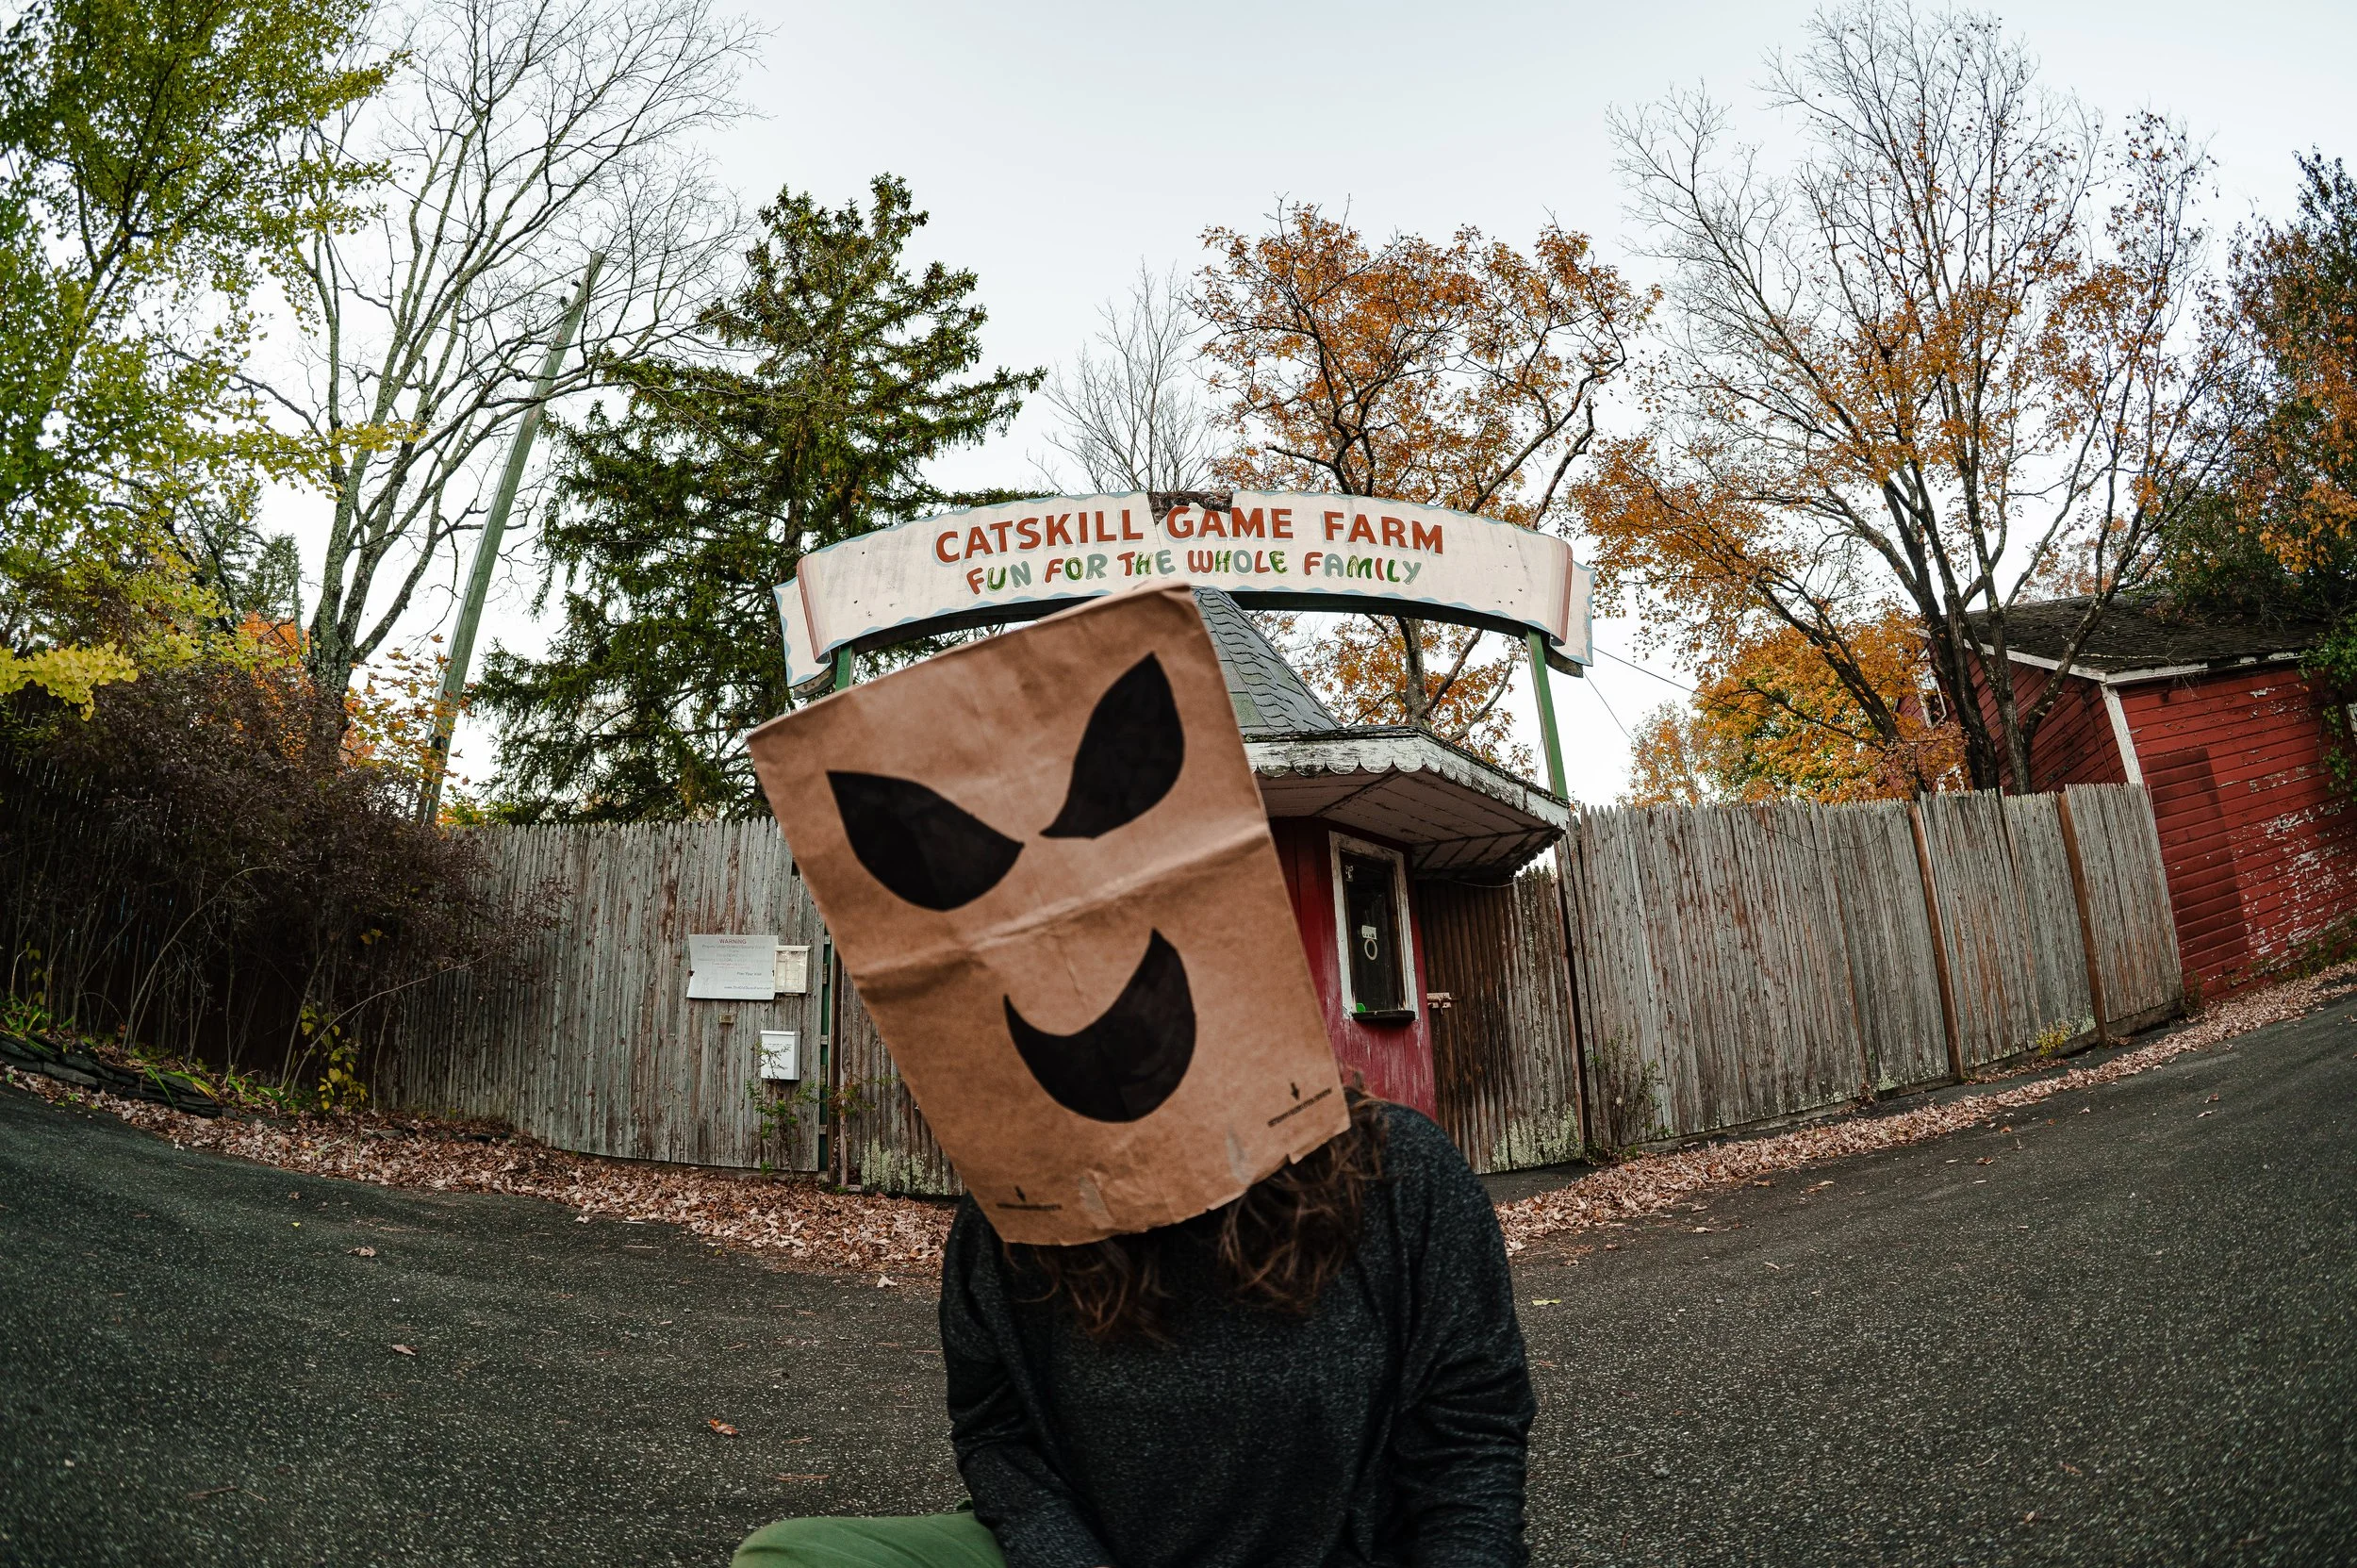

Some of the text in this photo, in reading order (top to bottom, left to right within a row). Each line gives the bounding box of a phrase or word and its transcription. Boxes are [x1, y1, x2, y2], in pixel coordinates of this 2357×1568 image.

[935, 505, 1443, 564] CATSKILL GAME FARM
[965, 549, 1422, 595] FUN FOR THE WHOLE FAMILY
